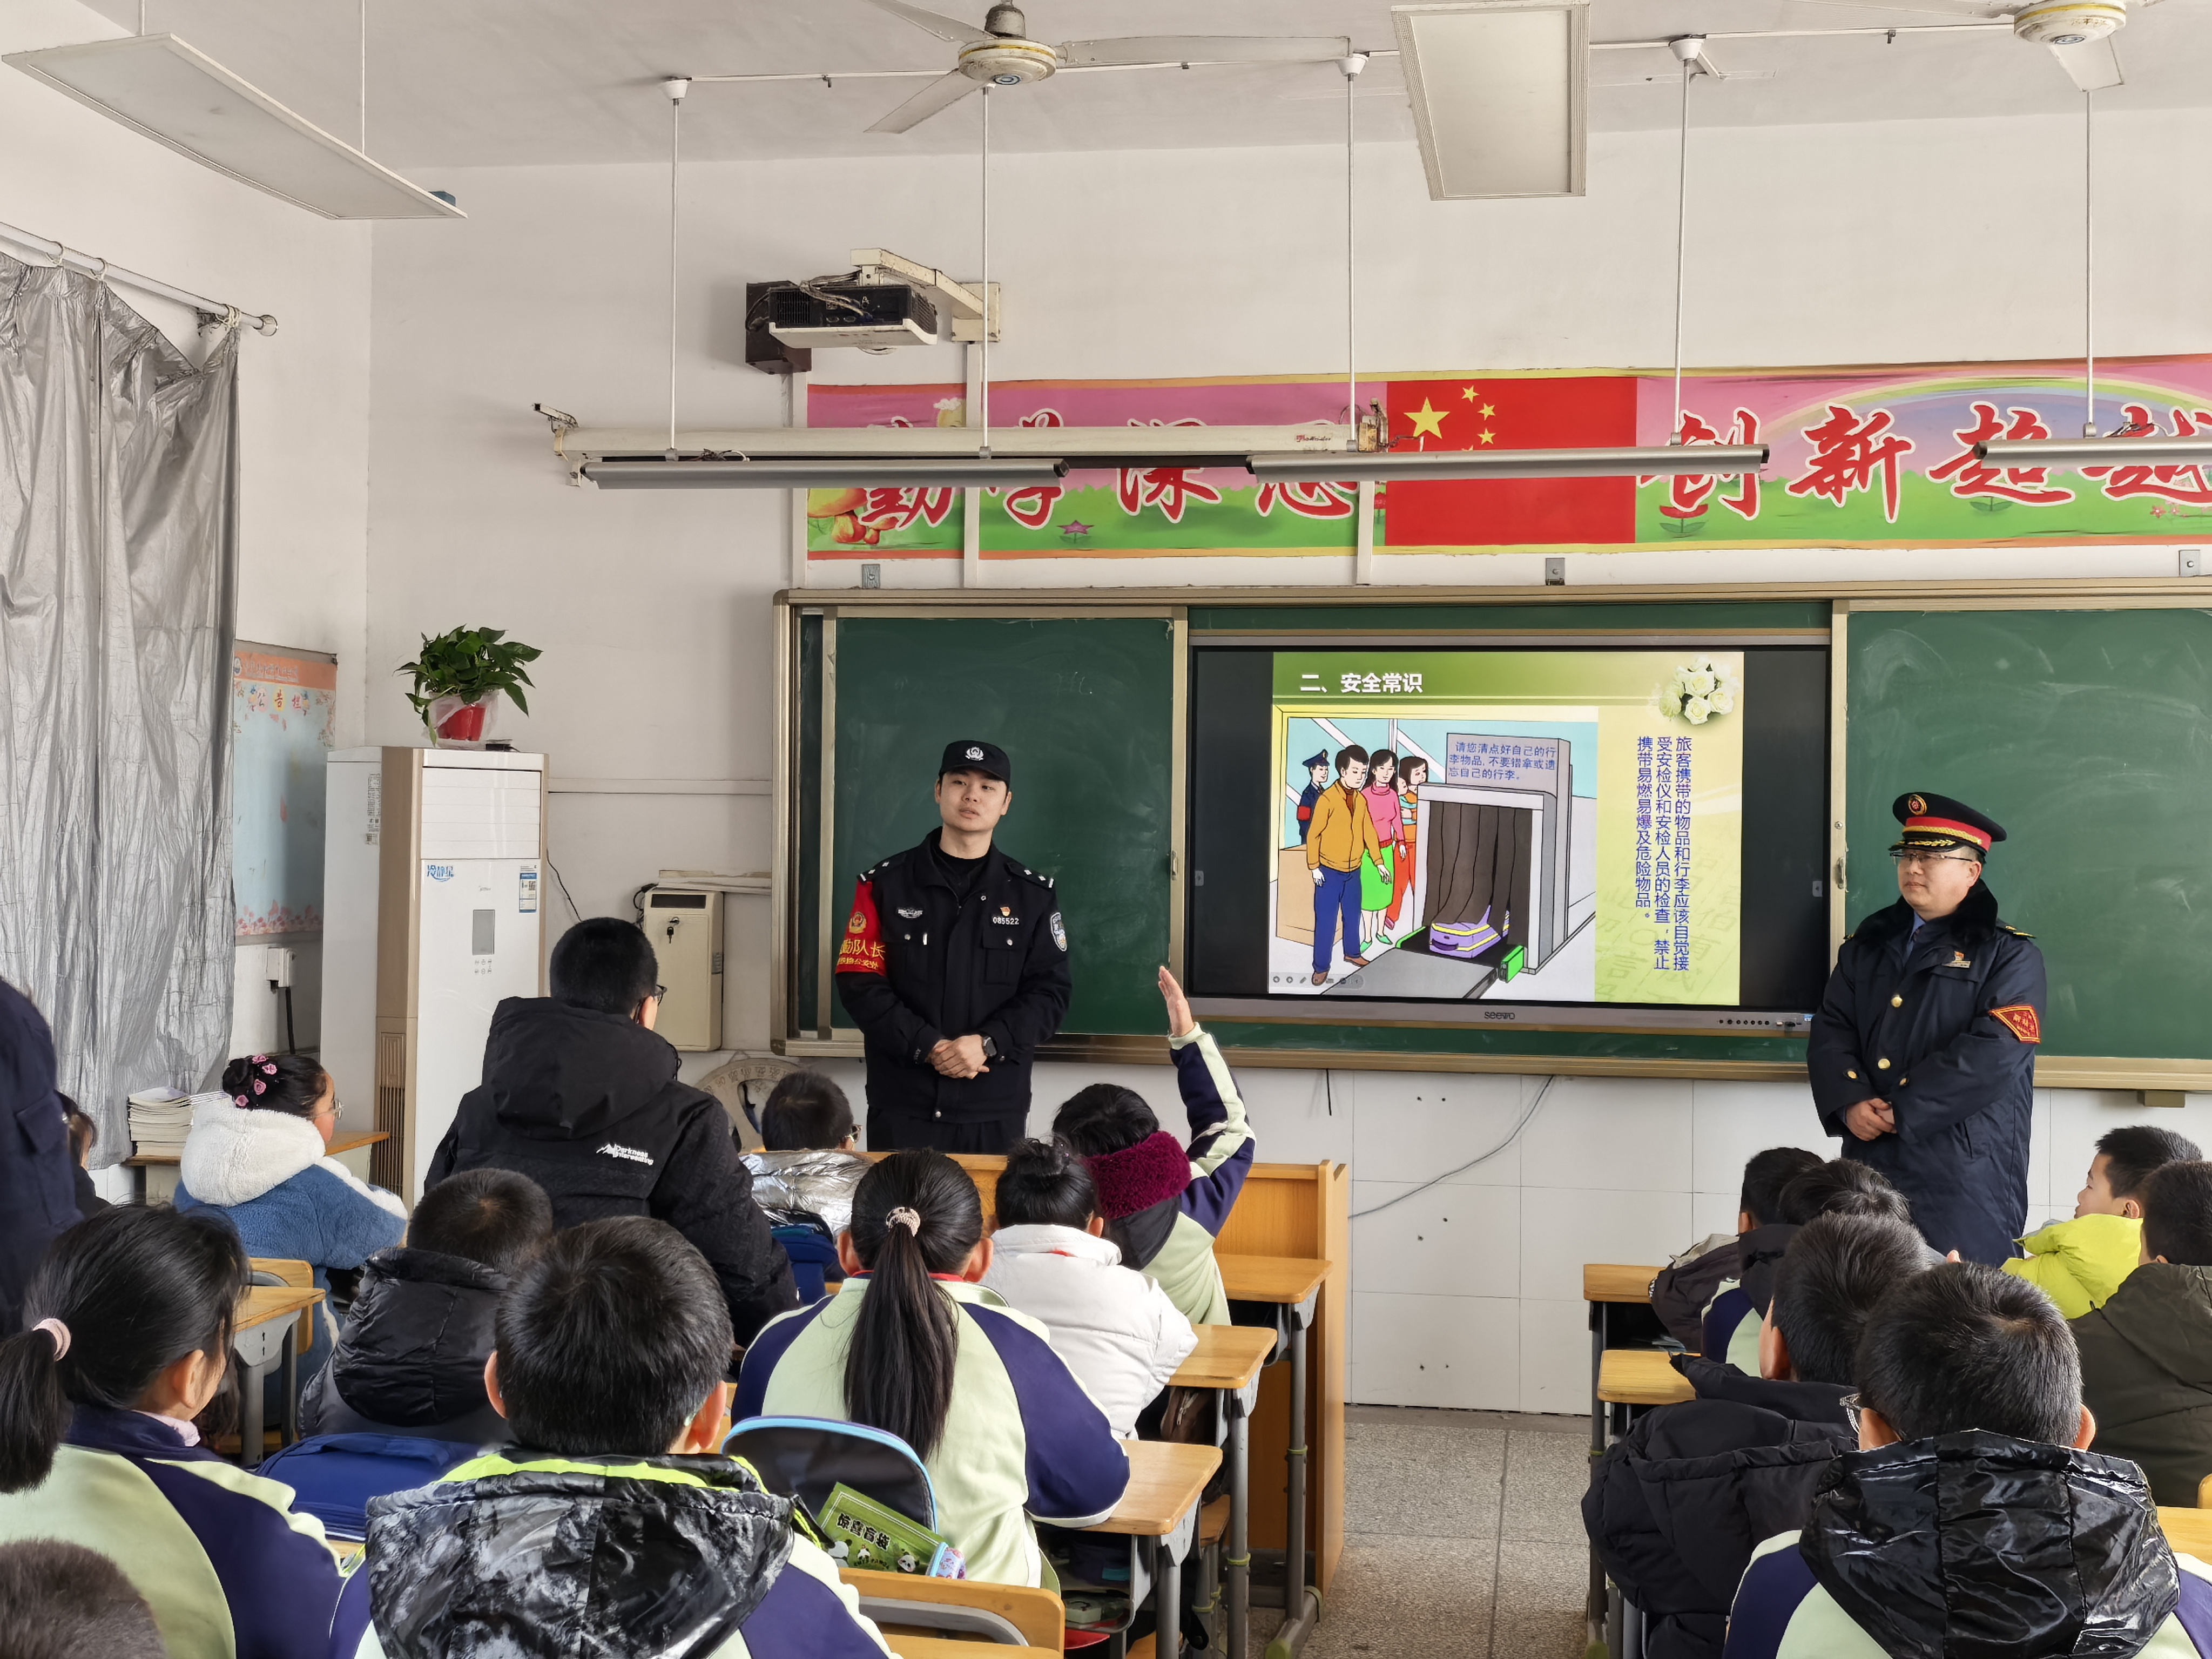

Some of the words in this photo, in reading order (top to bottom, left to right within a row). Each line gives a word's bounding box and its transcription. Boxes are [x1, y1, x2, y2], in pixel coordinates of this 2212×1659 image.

[1636, 402, 2212, 523] 创新超越
[1300, 673, 1423, 693] 二、安全常识
[1455, 741, 1556, 758] 请您清点好自己的行
[1448, 767, 1520, 780] 忘自己的行李。
[1674, 736, 1692, 971] 旅客携带的物品和行李应该自觉接
